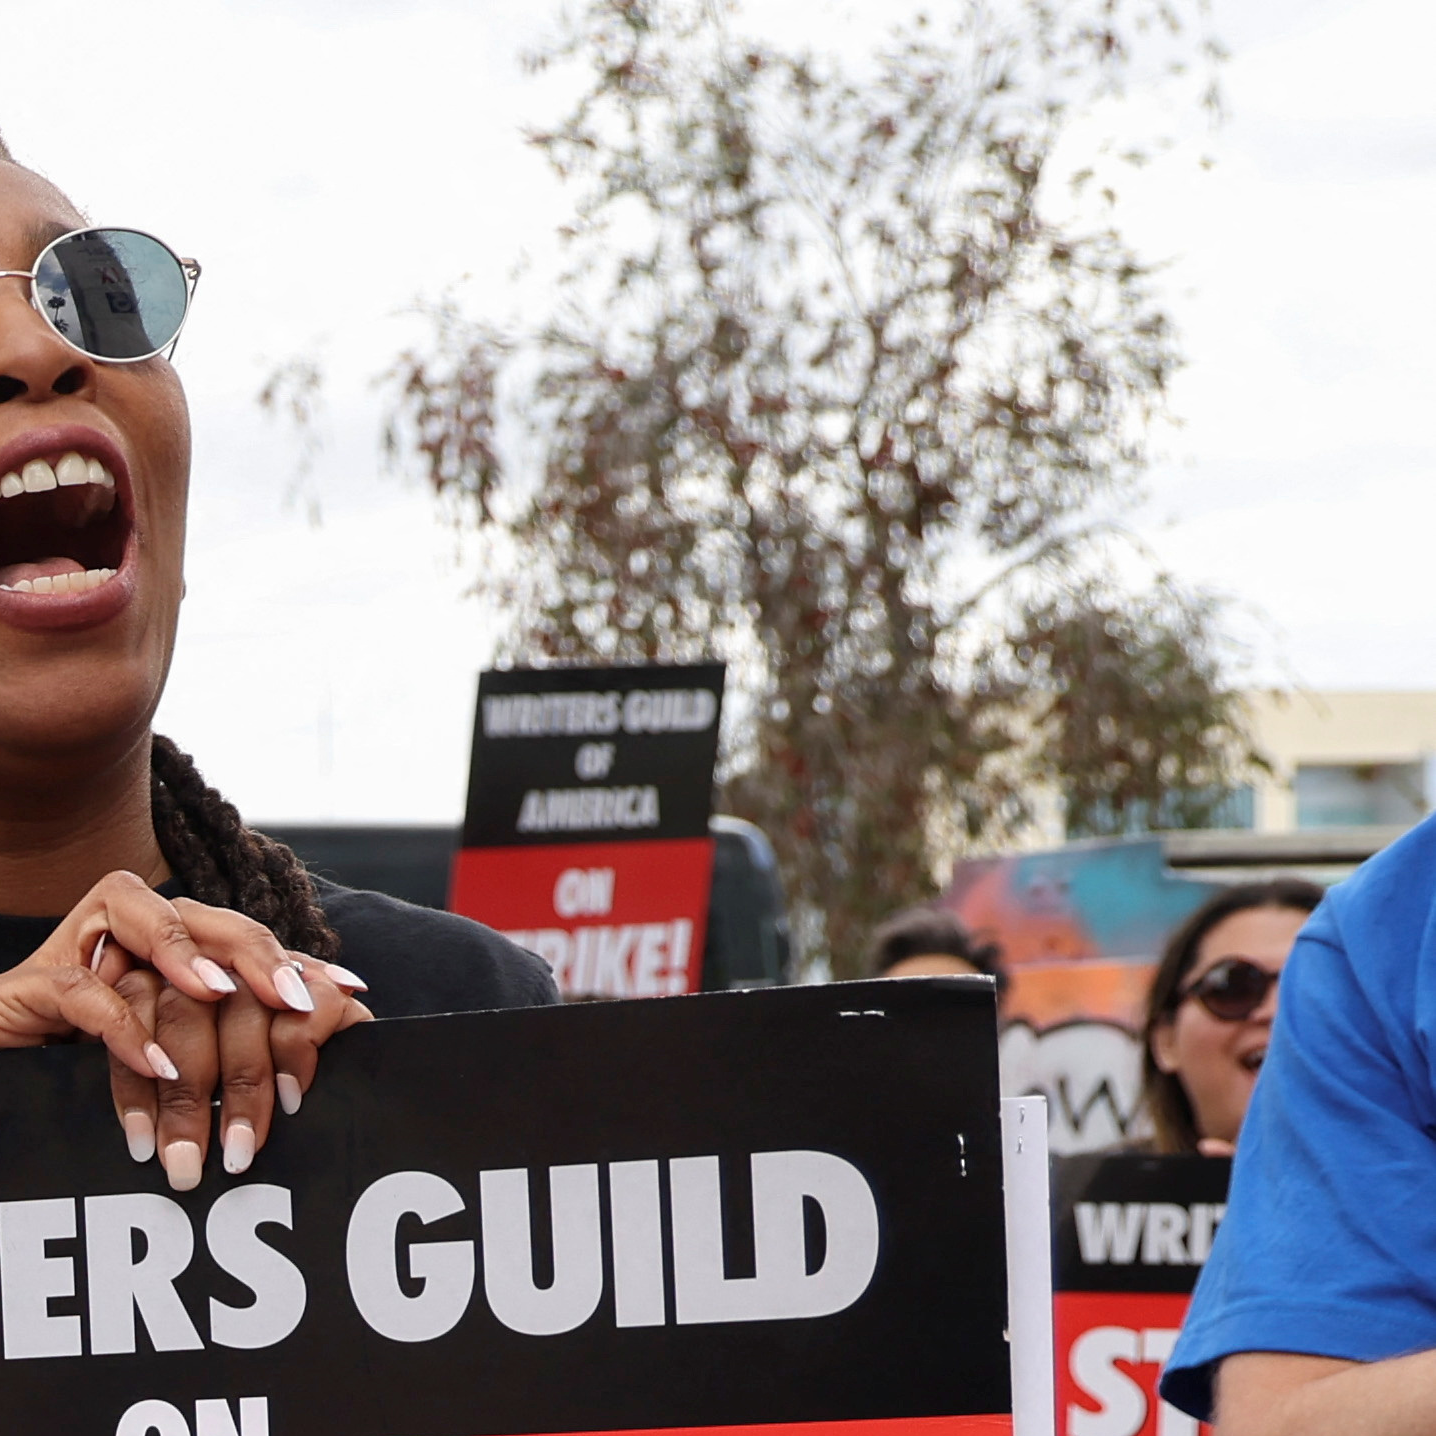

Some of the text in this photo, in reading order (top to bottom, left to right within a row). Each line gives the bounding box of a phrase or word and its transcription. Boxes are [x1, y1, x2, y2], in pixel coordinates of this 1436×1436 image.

[482, 688, 718, 738] WRITERS GUILD
[574, 742, 616, 781] OF
[516, 785, 661, 833] AMERICA
[553, 867, 616, 919] ON
[345, 1150, 882, 1344] GUILD
